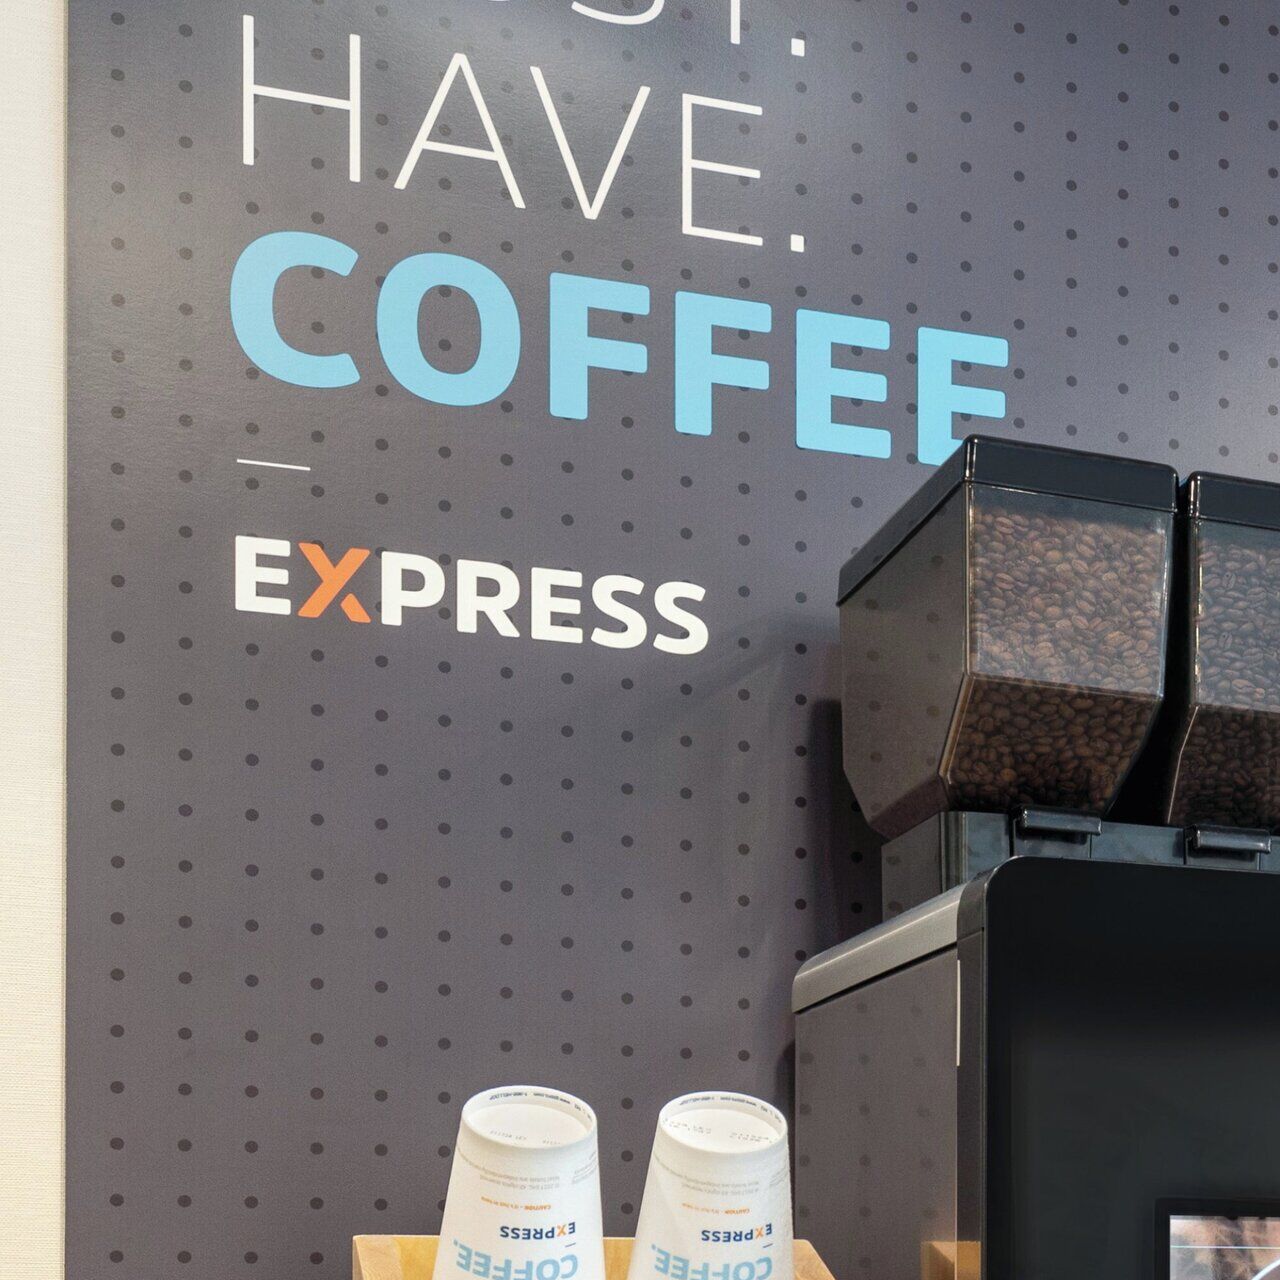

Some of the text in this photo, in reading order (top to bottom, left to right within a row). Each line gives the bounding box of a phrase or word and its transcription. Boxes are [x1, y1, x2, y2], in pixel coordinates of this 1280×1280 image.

[243, 14, 805, 252] HAVE.
[229, 230, 1009, 467] COFFEE
[234, 535, 710, 655] EXPRESS
[499, 1221, 576, 1241] EXPRESS
[701, 1222, 773, 1242] EXPRESS
